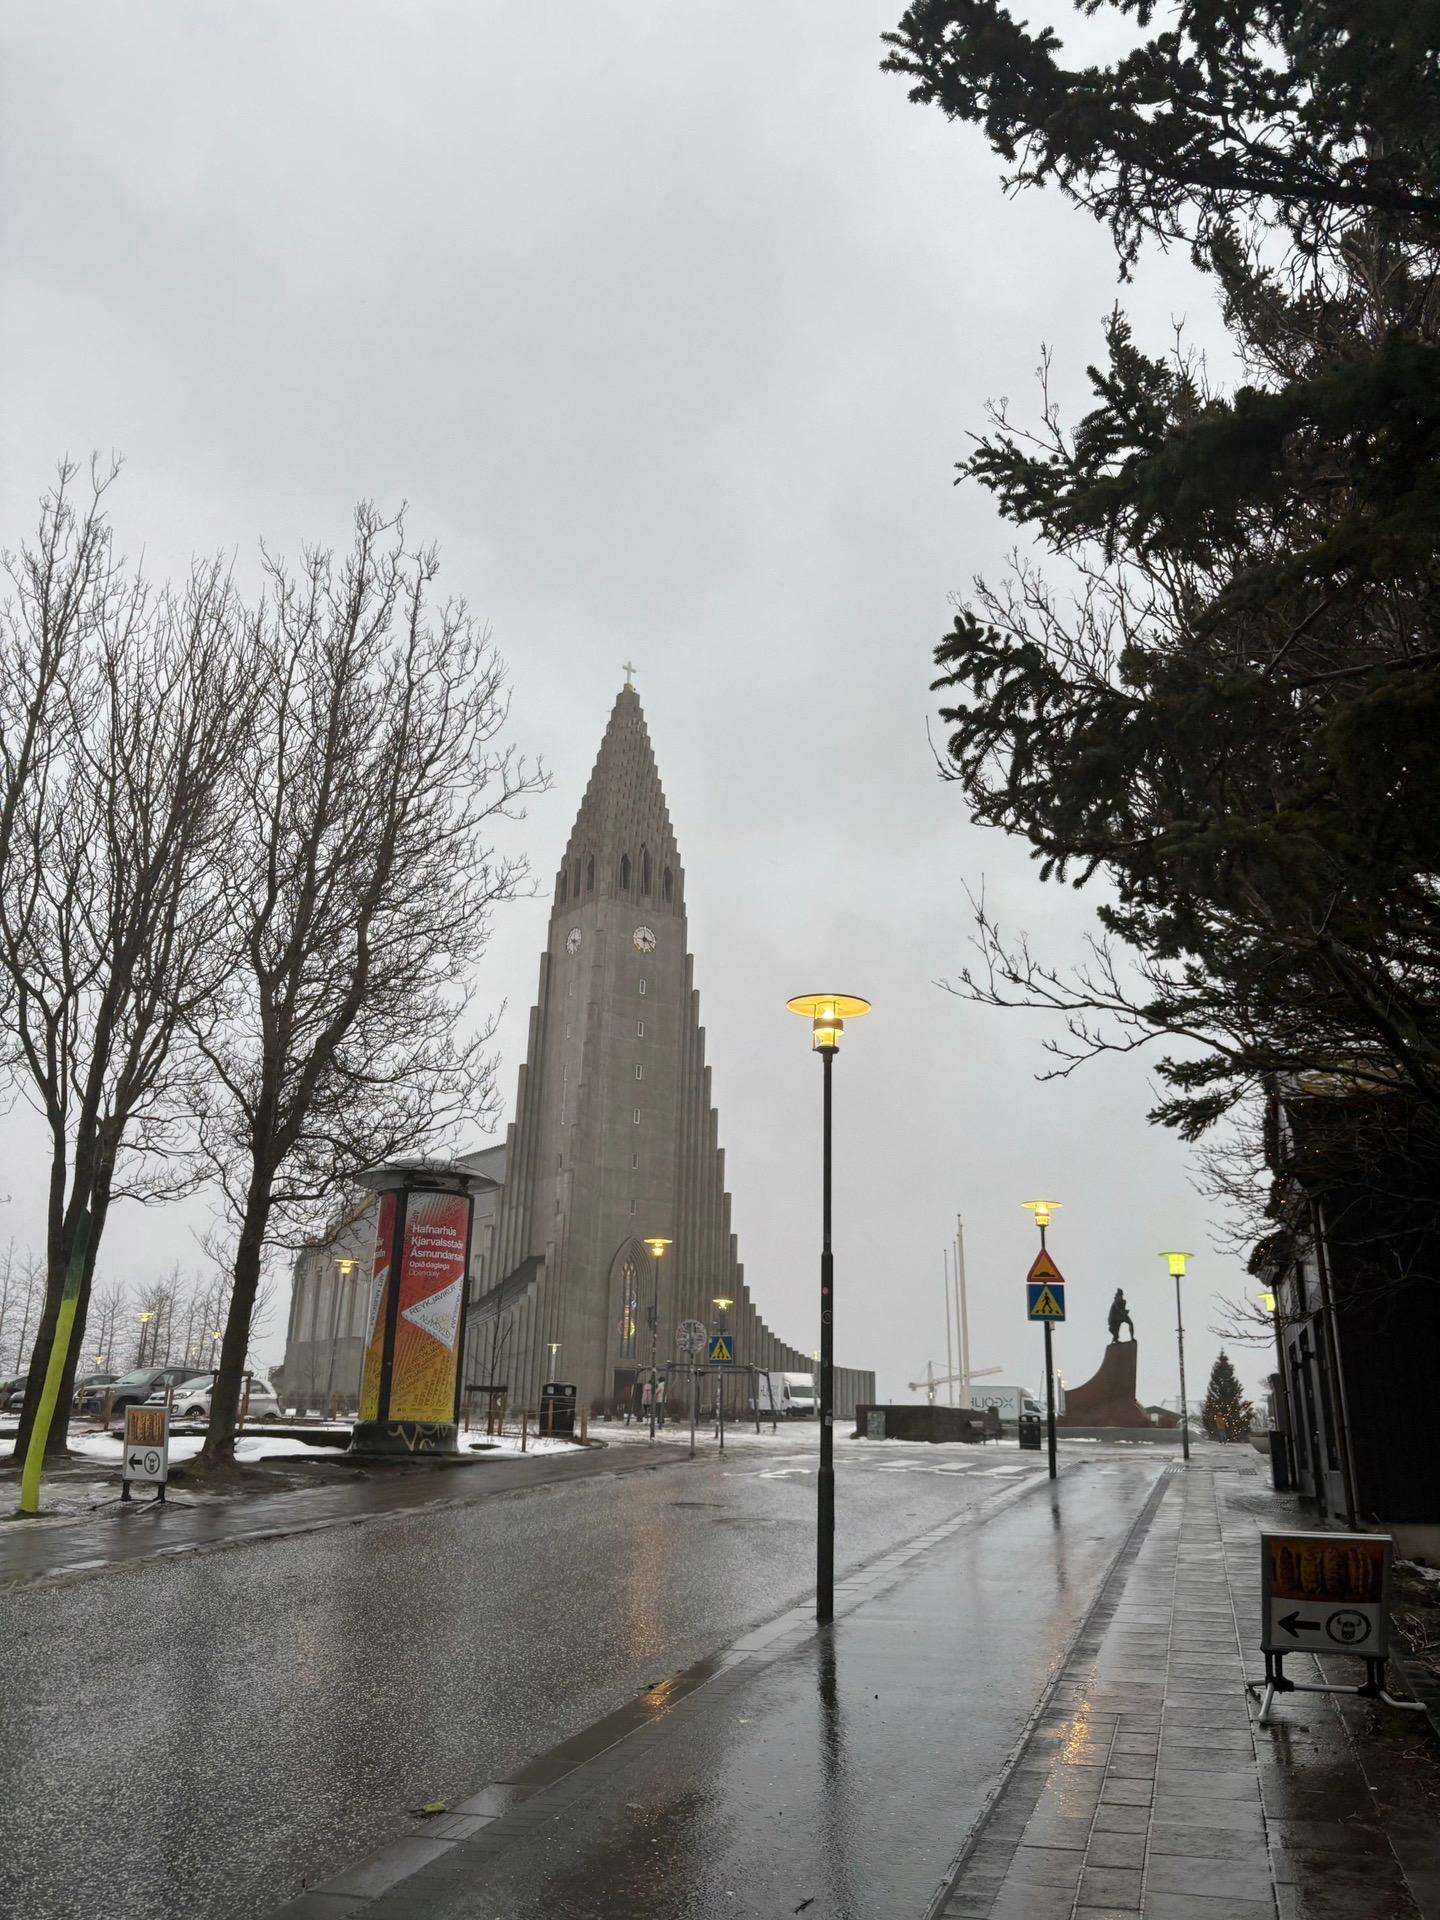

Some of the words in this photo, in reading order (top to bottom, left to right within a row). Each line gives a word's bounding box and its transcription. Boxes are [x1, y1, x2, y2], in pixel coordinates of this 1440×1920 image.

[412, 1224, 457, 1236] Hafnarhús
[409, 1260, 425, 1268] Opið
[426, 1261, 450, 1270] daglega
